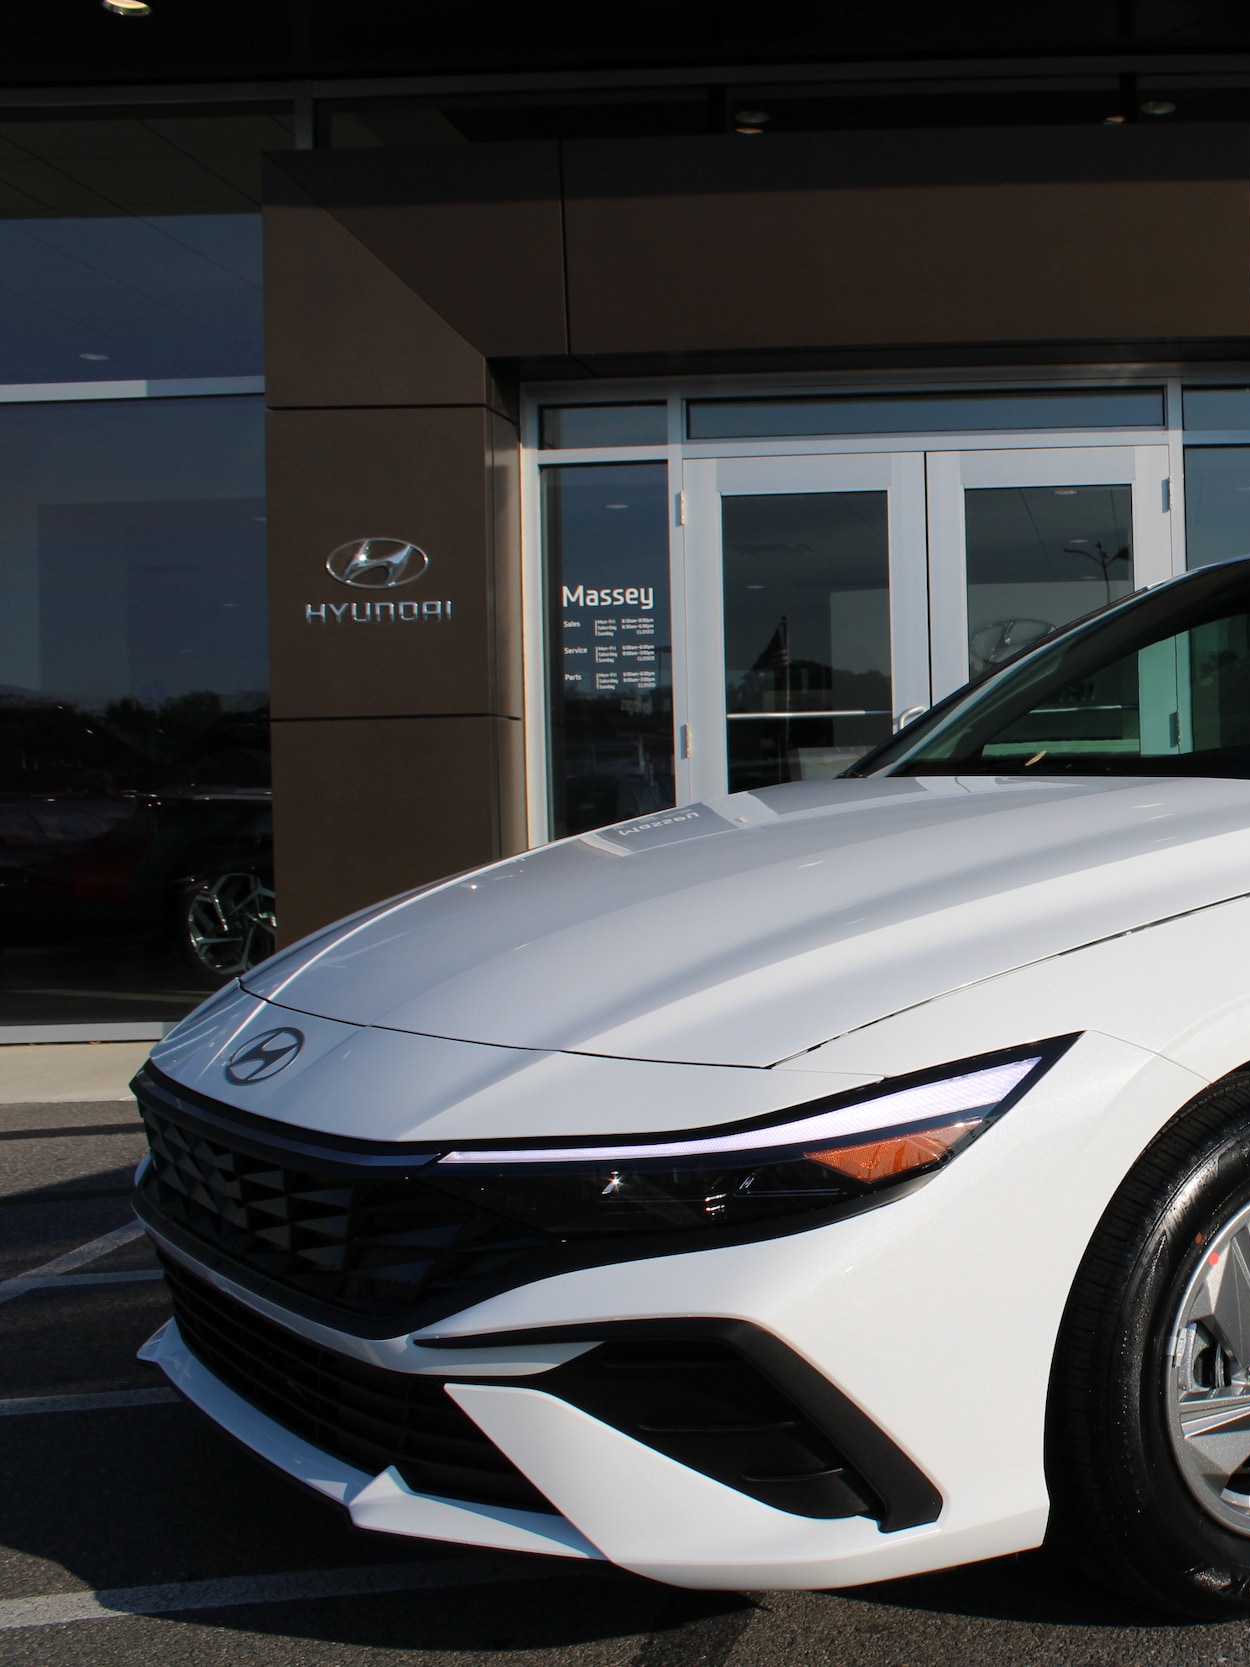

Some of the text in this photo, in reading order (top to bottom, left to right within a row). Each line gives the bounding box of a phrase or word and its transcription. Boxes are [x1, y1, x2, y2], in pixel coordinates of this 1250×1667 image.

[562, 585, 654, 610] Massey
[305, 600, 453, 624] HYUNDAI
[563, 620, 581, 628] Sales
[564, 647, 588, 655] Service
[564, 673, 582, 681] Parts
